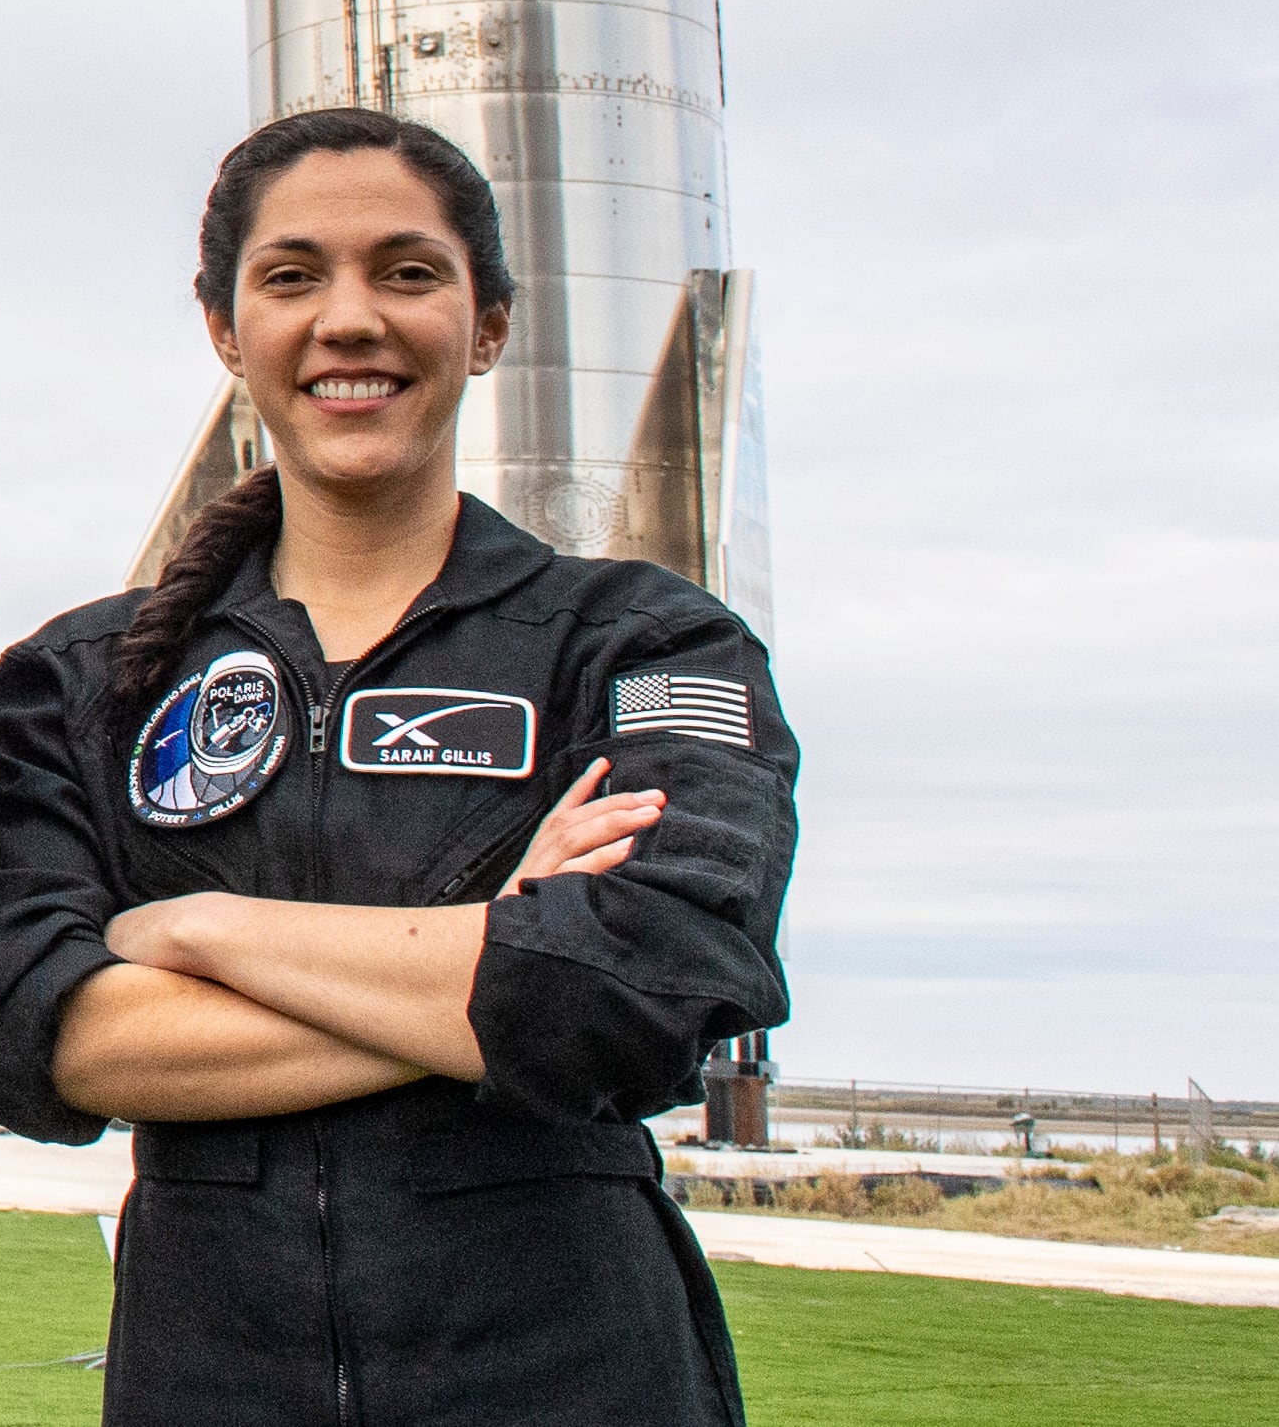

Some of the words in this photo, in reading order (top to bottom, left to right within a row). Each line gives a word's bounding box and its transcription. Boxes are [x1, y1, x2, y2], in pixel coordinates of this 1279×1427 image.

[209, 680, 265, 700] POLARIS
[379, 748, 435, 762] SARAH
[441, 748, 493, 765] GILLIS
